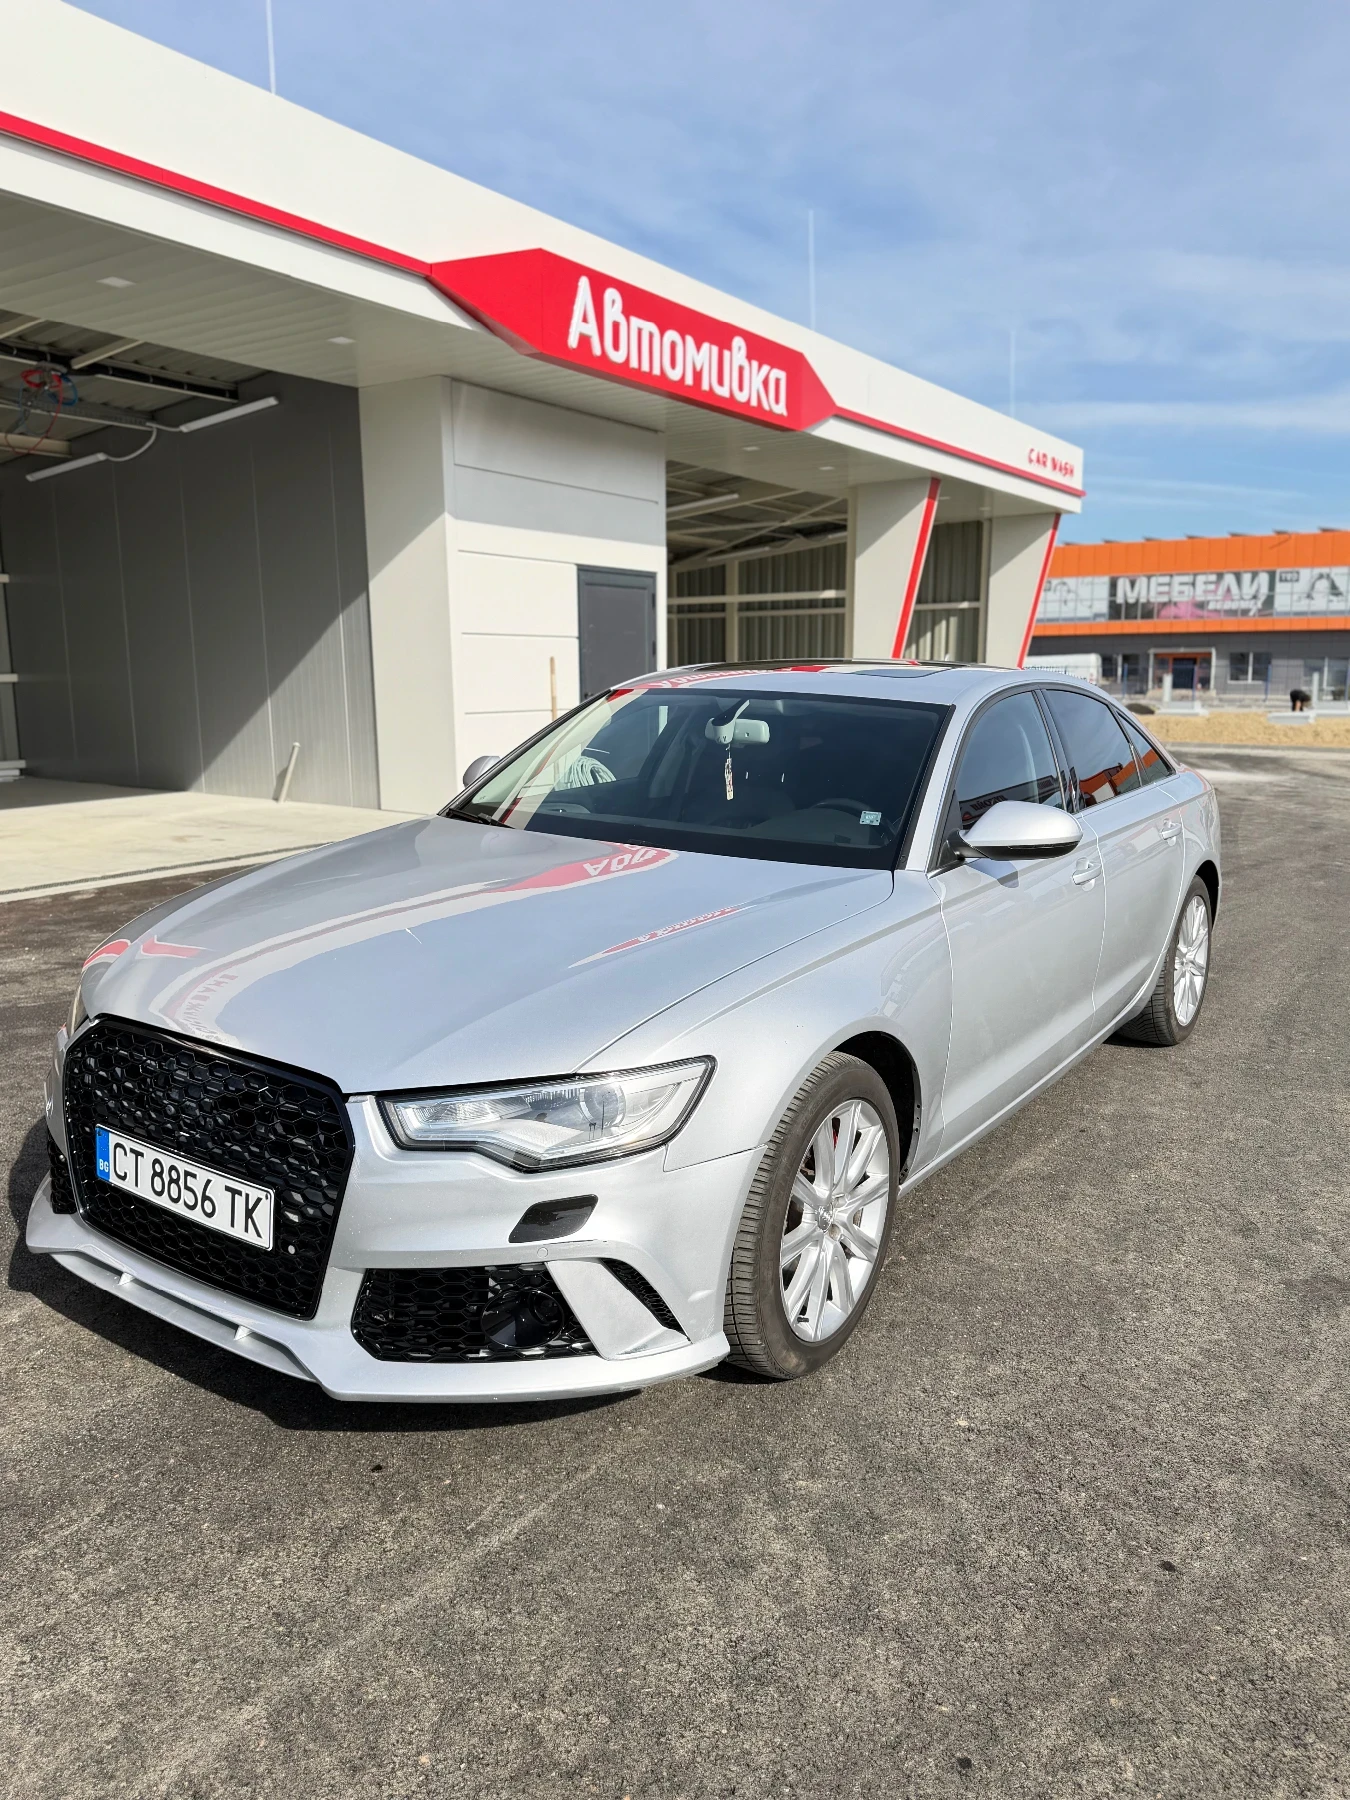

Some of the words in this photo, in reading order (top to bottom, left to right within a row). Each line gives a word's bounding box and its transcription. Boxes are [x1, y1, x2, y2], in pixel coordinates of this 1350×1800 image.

[567, 275, 788, 416] Автомивка
[1027, 450, 1047, 468] CAR
[1051, 456, 1074, 477] WASH
[1116, 572, 1269, 605] МЕБЕЛИ
[99, 1158, 109, 1173] BG
[113, 1142, 145, 1188] CT
[150, 1157, 217, 1219] 8856
[224, 1184, 263, 1240] TK
